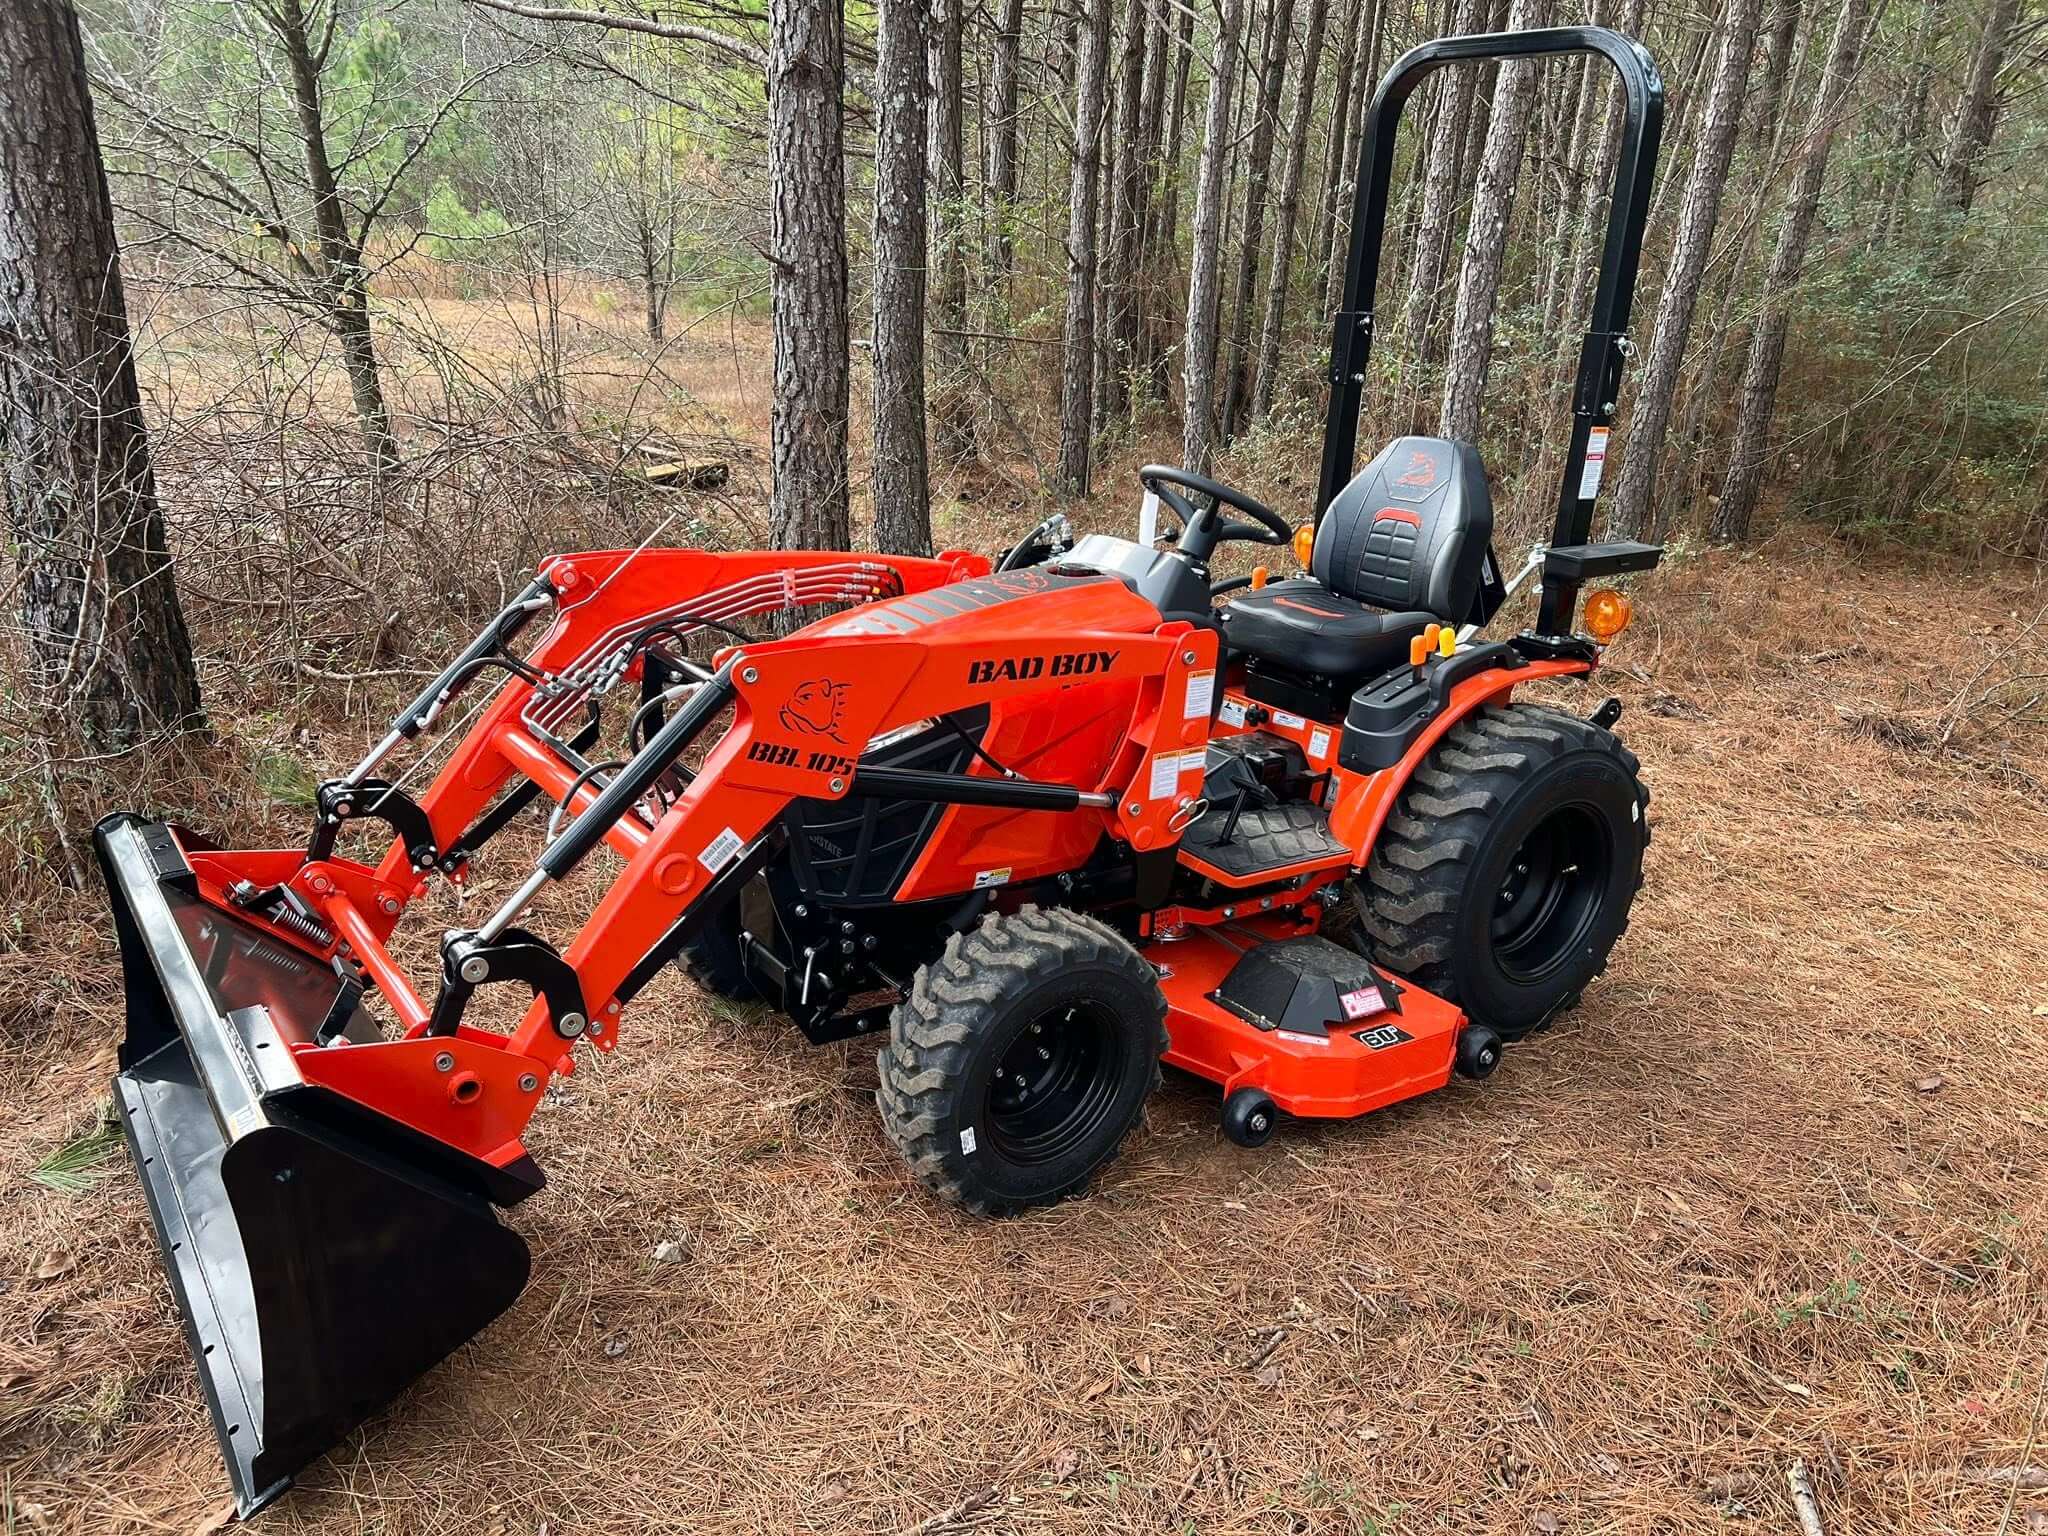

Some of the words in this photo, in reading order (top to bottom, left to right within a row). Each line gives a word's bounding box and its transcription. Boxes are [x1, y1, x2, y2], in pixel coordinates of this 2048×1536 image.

[967, 656, 1044, 685] BAD
[1050, 650, 1120, 677] BOY
[747, 742, 801, 768] BBL
[806, 753, 857, 776] 105
